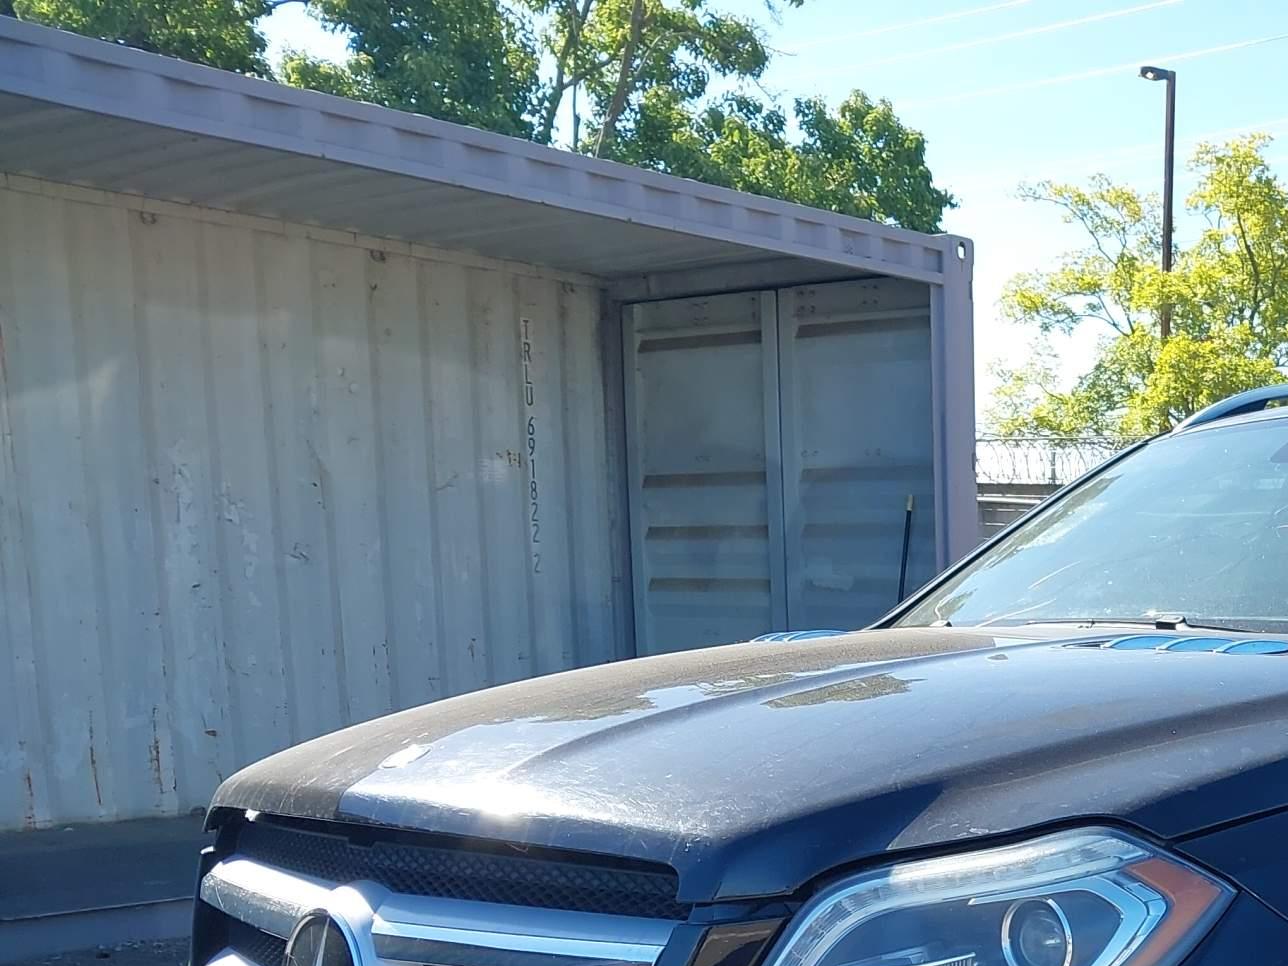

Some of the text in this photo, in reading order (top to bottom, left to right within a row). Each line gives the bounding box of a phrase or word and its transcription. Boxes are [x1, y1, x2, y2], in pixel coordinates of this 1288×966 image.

[521, 319, 541, 574] TRLU 691822 2
